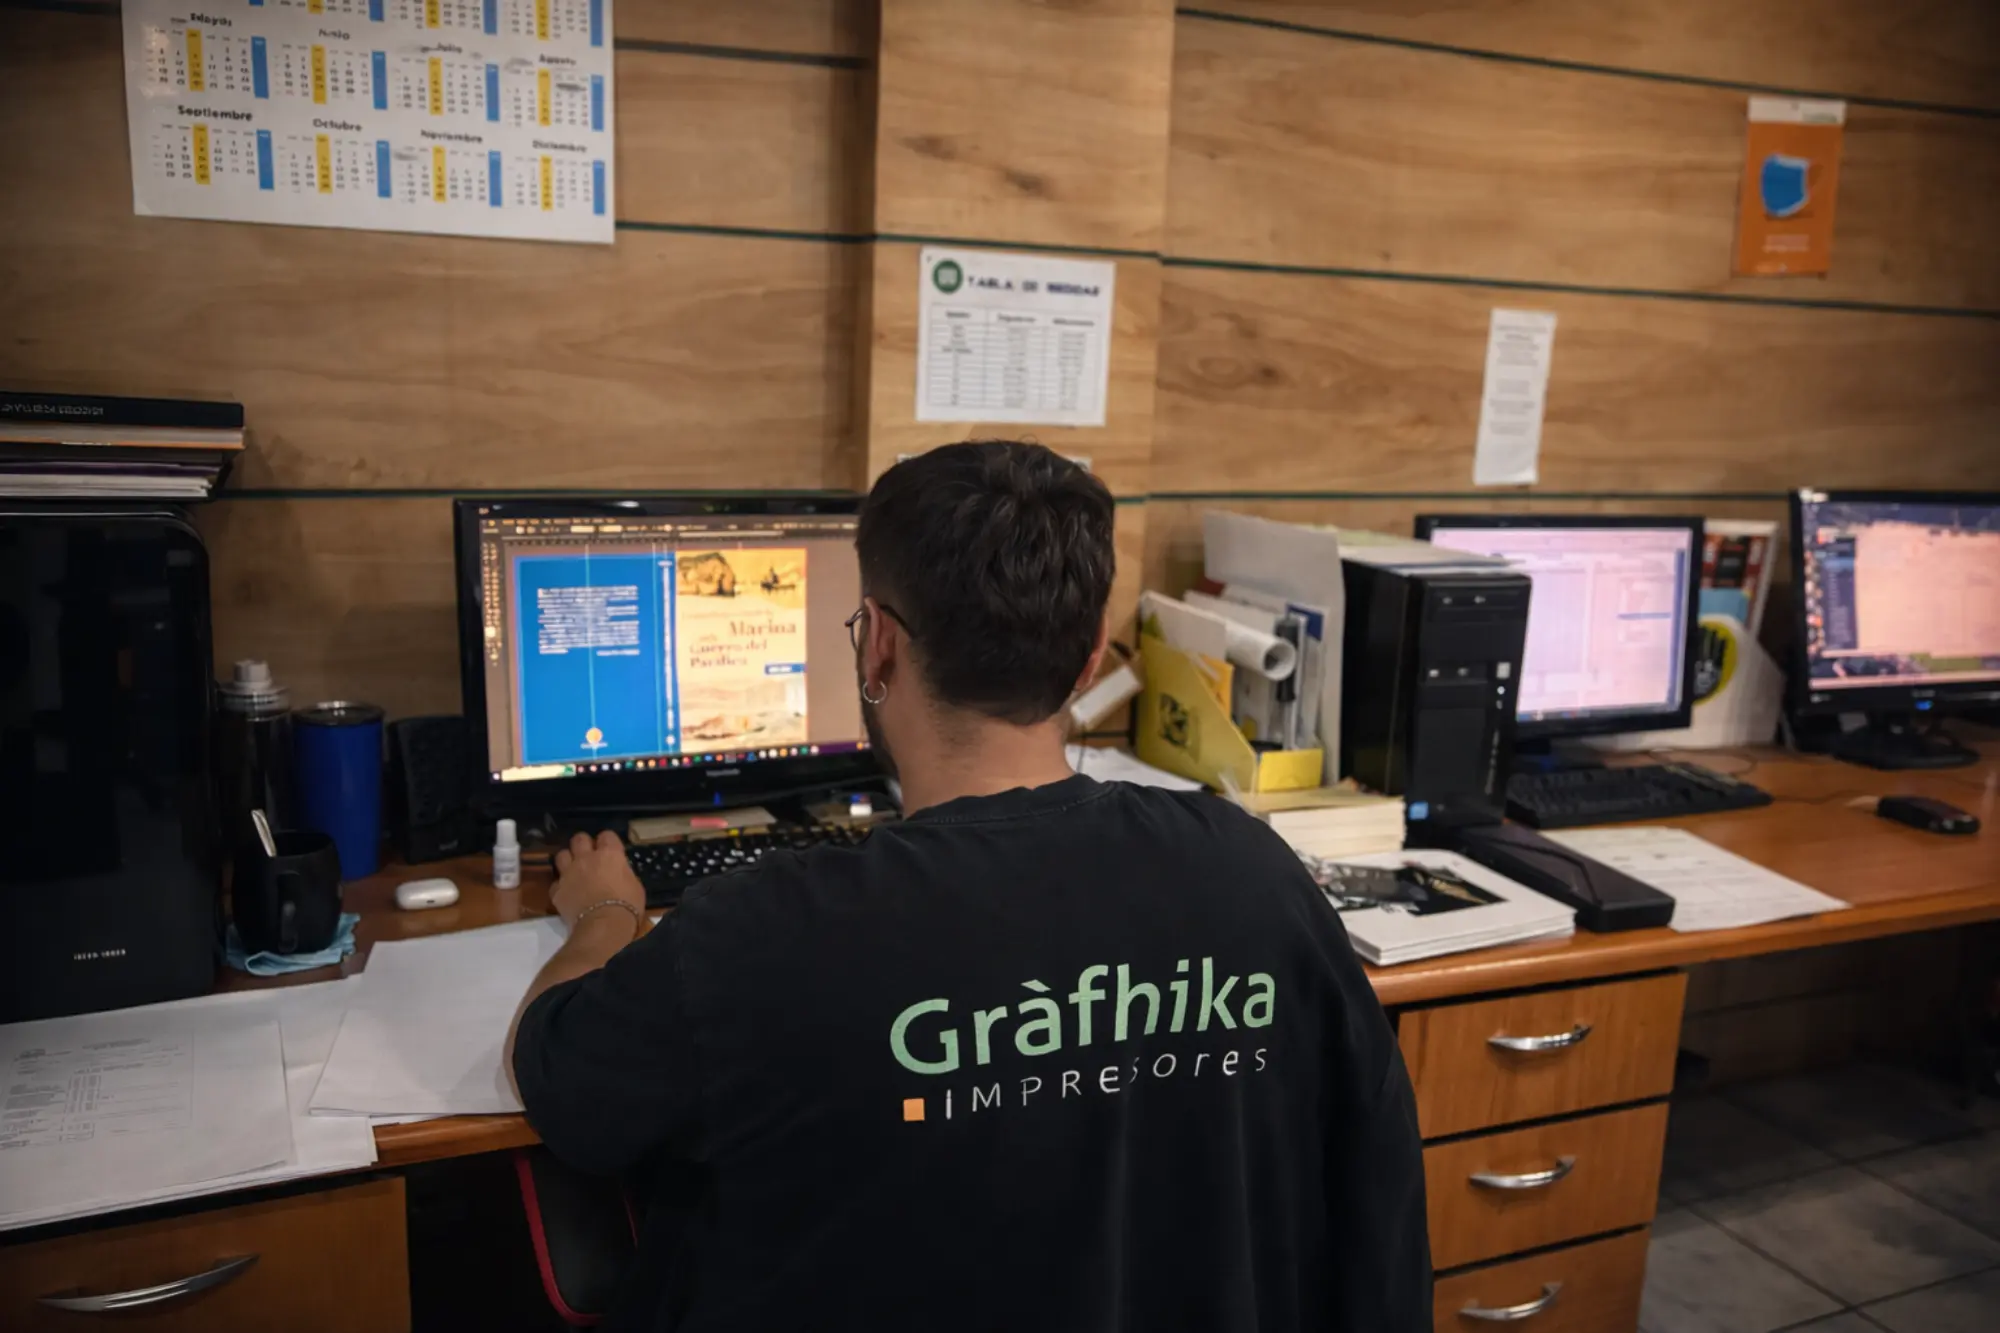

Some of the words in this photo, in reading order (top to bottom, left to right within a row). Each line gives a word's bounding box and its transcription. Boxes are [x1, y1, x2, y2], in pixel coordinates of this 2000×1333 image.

[177, 104, 254, 122] Septiembre
[312, 118, 363, 133] Octubre
[729, 618, 797, 637] Marina
[889, 955, 1277, 1076] Gràfhika
